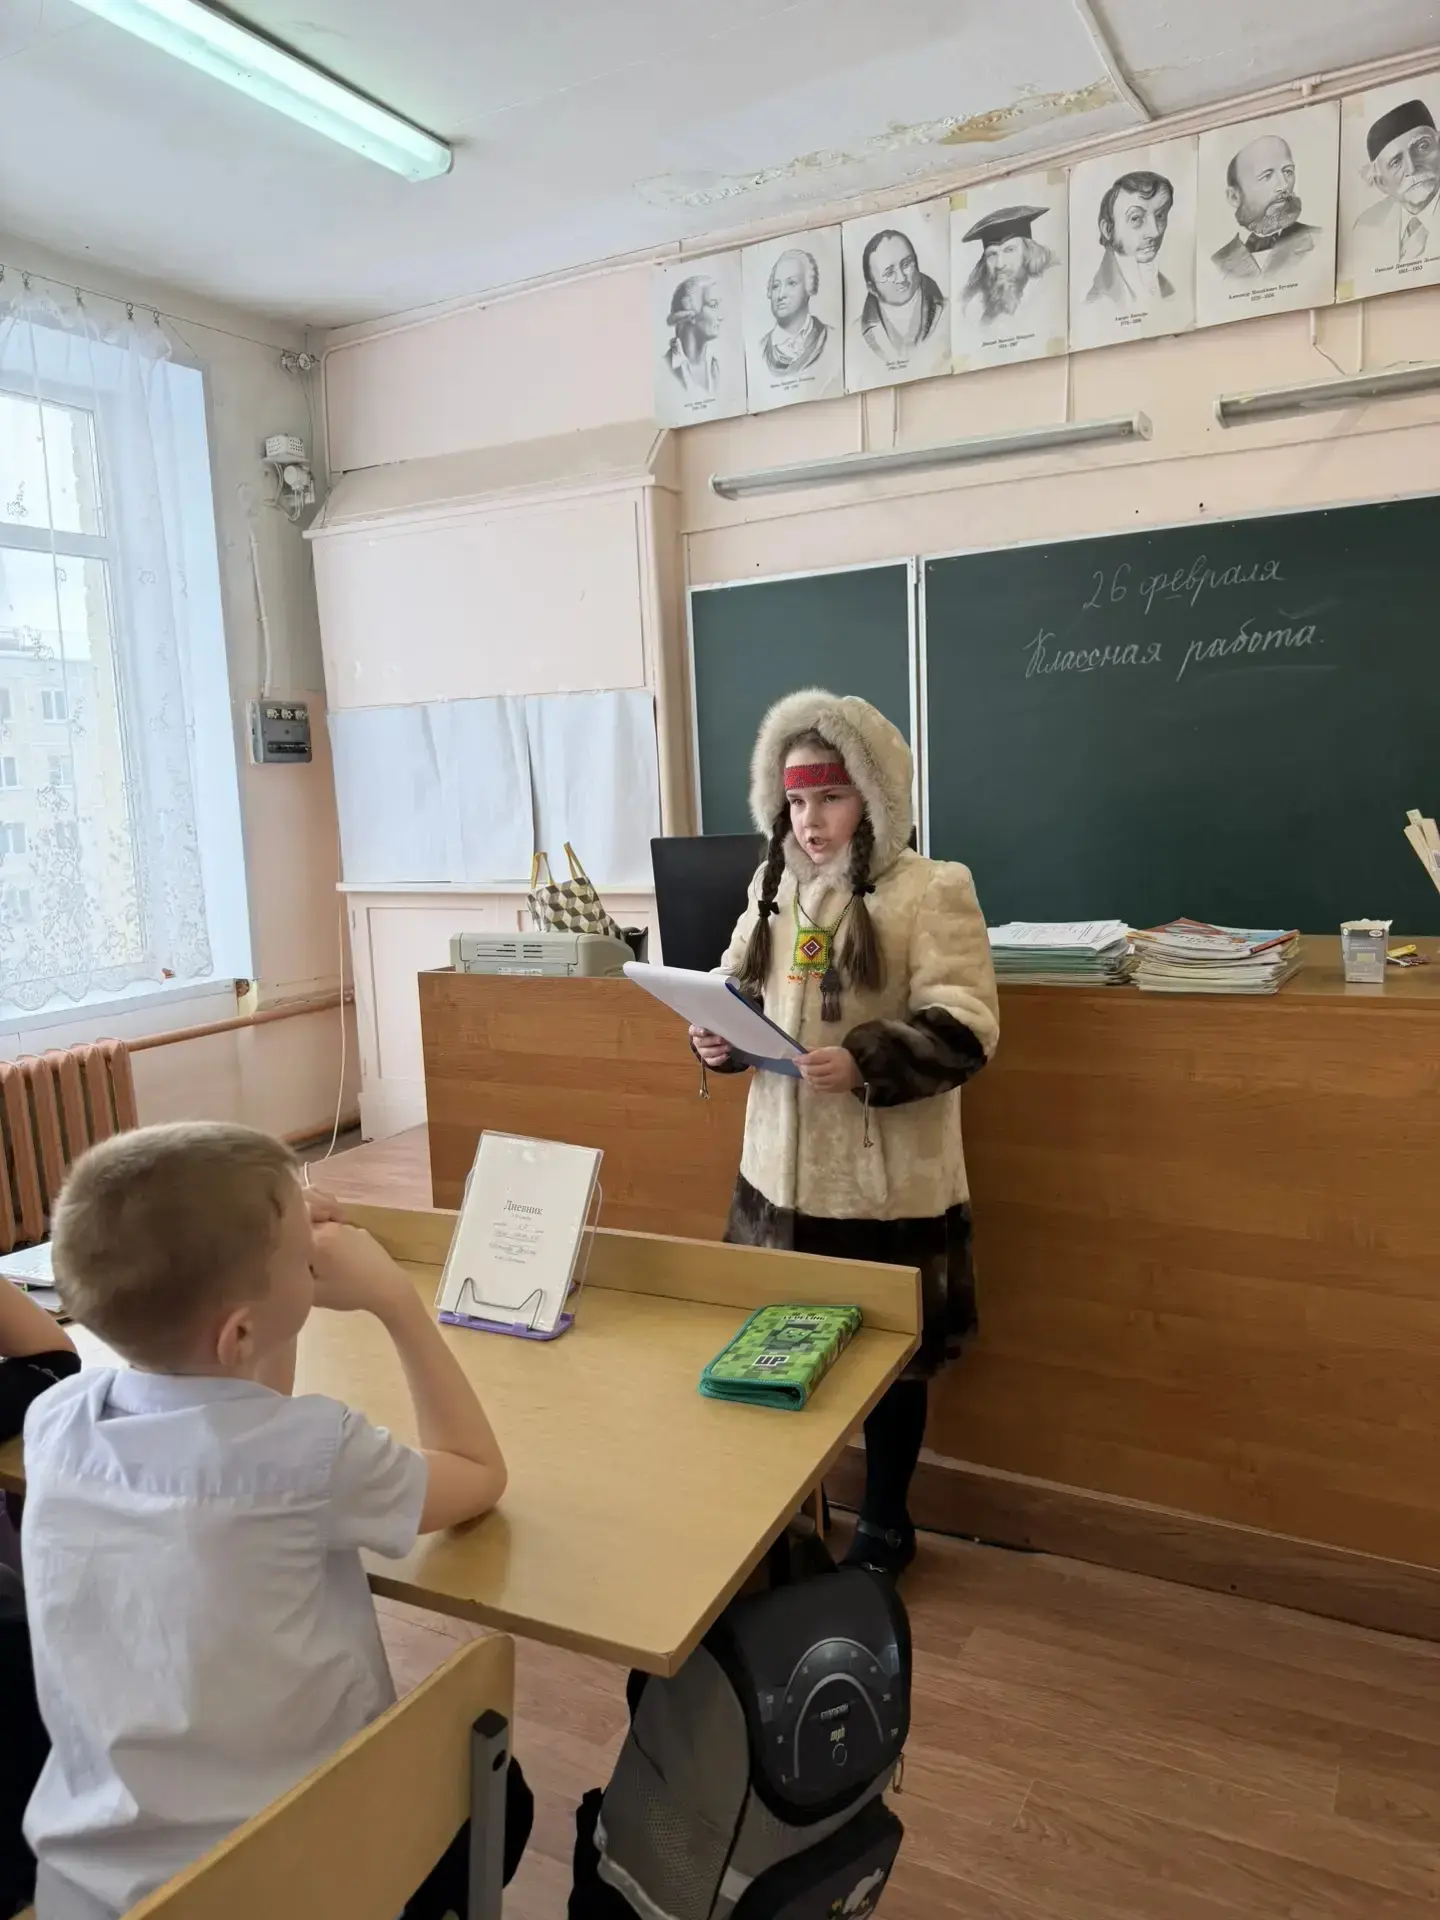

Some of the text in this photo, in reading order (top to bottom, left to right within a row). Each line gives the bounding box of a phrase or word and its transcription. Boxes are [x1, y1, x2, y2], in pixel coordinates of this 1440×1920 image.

[1082, 554, 1286, 616] 26 февраля
[1022, 628, 1163, 680] Классная
[503, 1199, 544, 1215] Дневник
[754, 1355, 788, 1366] UP
